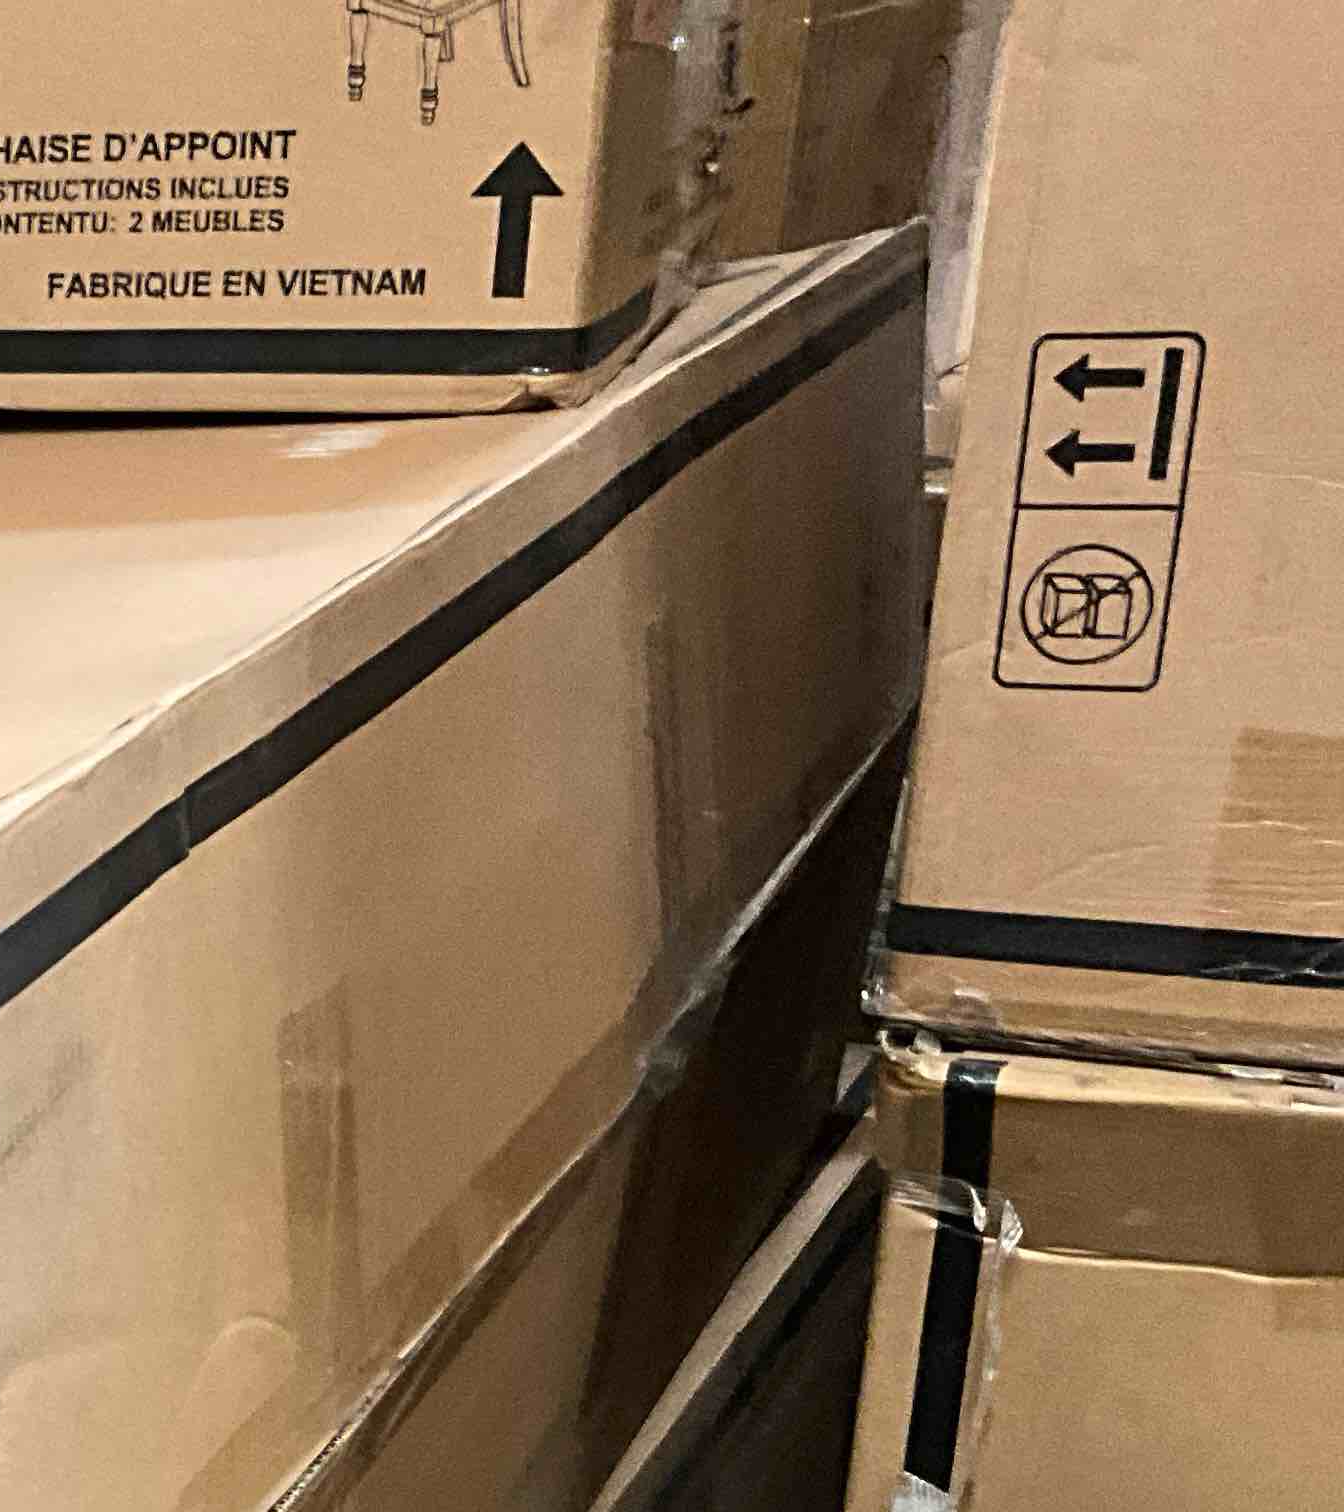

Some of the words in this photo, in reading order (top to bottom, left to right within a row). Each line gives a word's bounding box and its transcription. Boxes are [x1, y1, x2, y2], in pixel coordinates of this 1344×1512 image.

[103, 129, 297, 163] D'APPOINT
[169, 175, 290, 201] INCLUES
[128, 210, 145, 234] 2
[150, 208, 285, 234] MEUBLES
[47, 271, 212, 300] FABRIQUE
[221, 269, 267, 298] EN
[277, 268, 427, 297] VIETNAM
